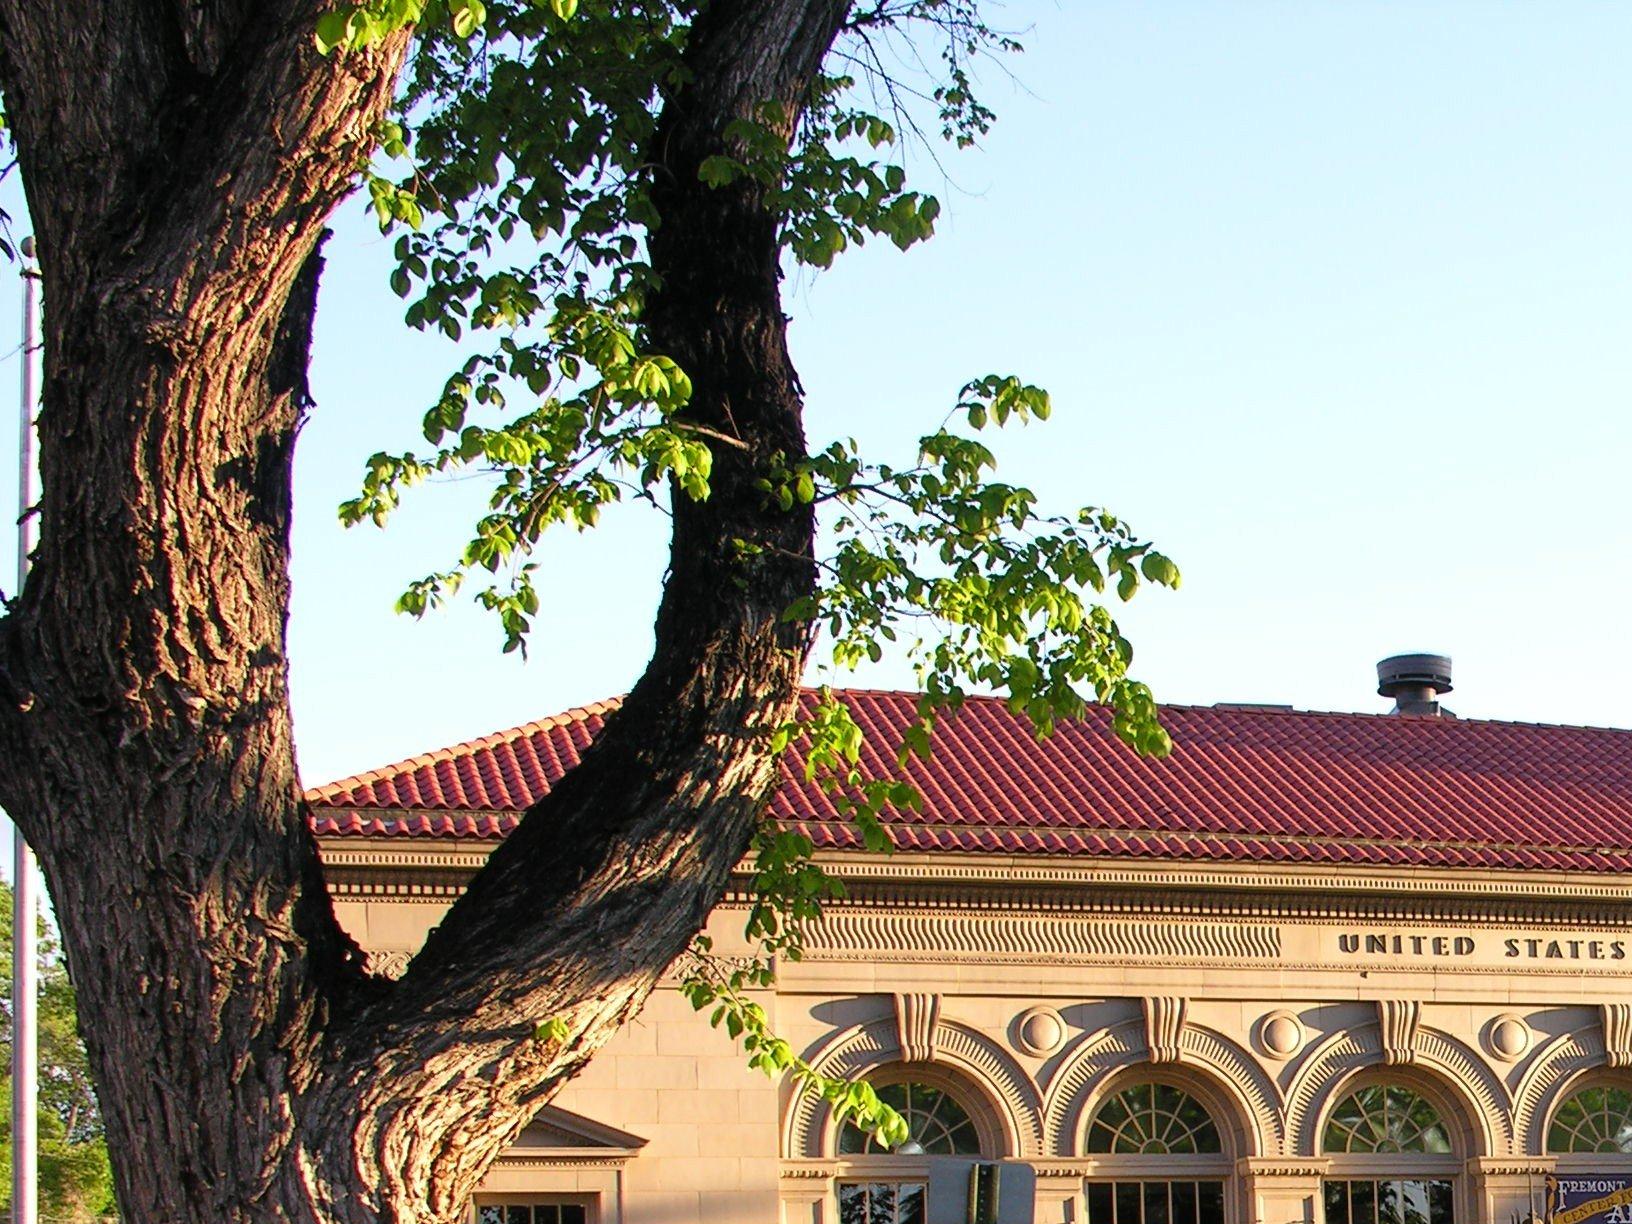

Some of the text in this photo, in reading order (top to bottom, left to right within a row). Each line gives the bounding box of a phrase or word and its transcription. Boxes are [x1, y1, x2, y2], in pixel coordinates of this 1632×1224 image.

[1338, 934, 1475, 956] UNITED
[1504, 938, 1626, 960] STATES
[1556, 1180, 1626, 1213] FREMONT
[1563, 1196, 1615, 1224] CENTER
